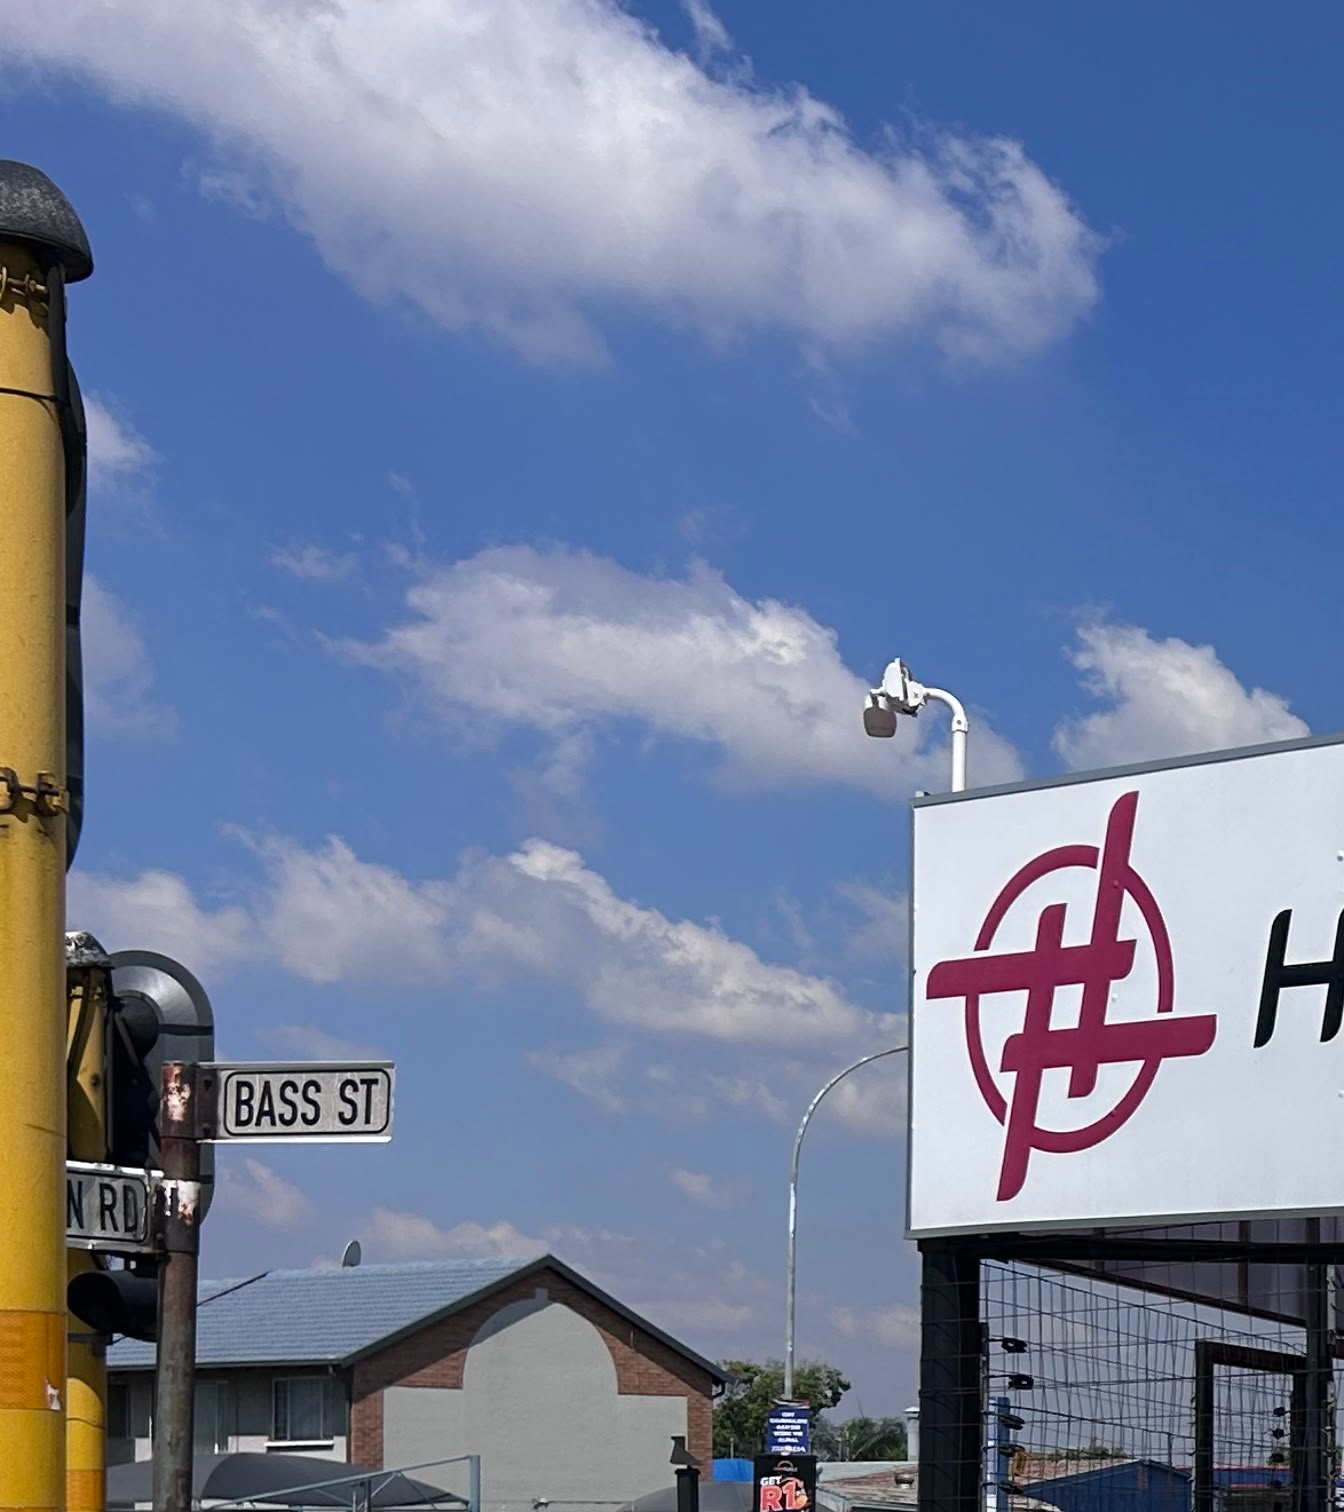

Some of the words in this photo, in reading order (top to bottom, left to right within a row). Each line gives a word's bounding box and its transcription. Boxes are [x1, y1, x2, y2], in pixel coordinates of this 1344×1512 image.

[234, 1079, 322, 1127] BASS
[338, 1078, 379, 1125] ST
[66, 1179, 84, 1229] N
[99, 1182, 139, 1233] RD
[760, 1475, 782, 1486] GET
